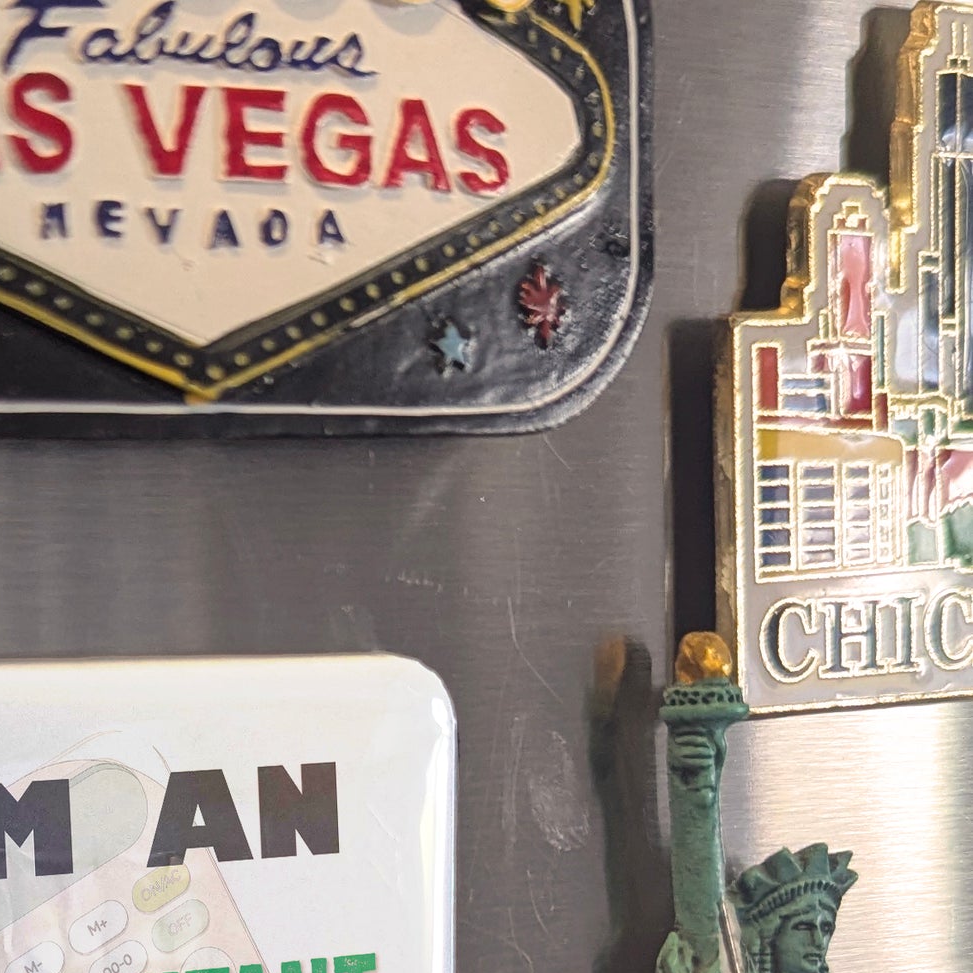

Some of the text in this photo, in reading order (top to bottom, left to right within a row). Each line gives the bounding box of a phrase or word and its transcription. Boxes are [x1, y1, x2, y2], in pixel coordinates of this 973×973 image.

[0, 0, 377, 76] Fabulous
[122, 83, 510, 195] VEGAS
[146, 761, 340, 868] AN
